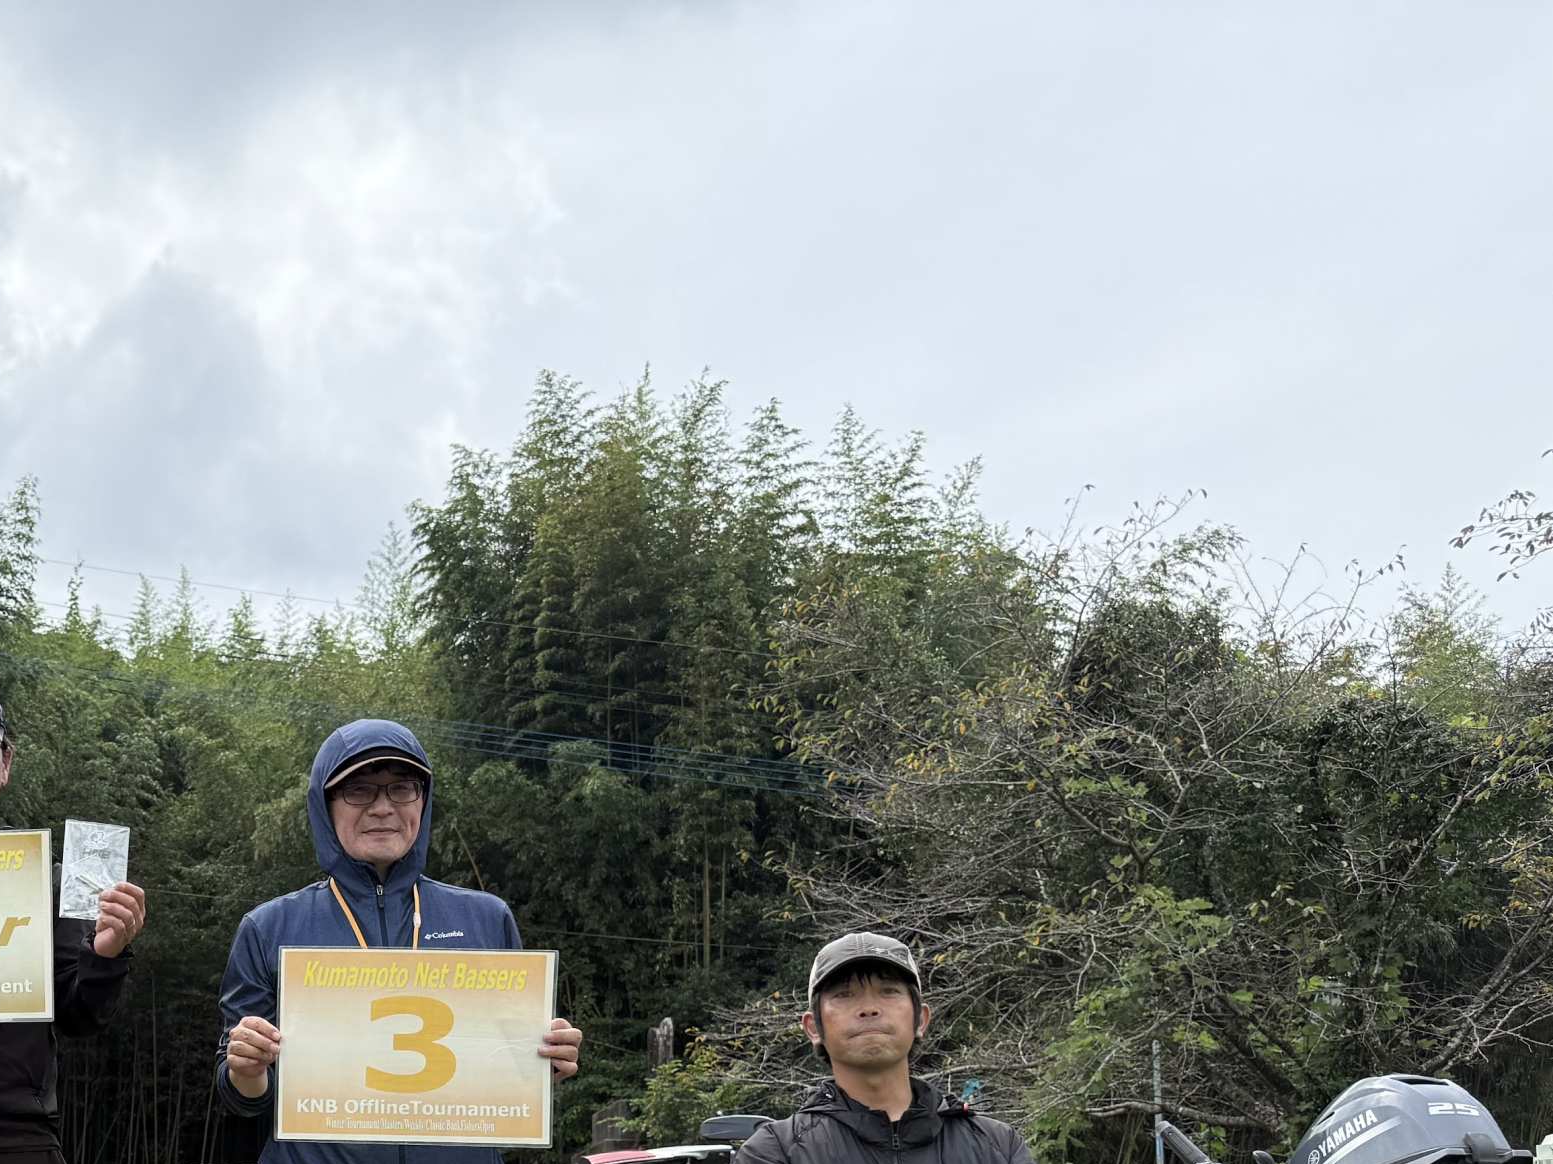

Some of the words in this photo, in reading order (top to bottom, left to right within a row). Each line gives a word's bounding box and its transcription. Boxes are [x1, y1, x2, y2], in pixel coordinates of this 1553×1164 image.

[303, 960, 409, 989] Kumamoto
[412, 962, 449, 989] Net
[453, 963, 528, 992] Bassers
[365, 995, 457, 1094] 3
[296, 1098, 337, 1114] KNB
[345, 1099, 530, 1118] OfflineTournament
[1427, 1102, 1480, 1116] 25
[1318, 1108, 1377, 1158] YAMAHA
